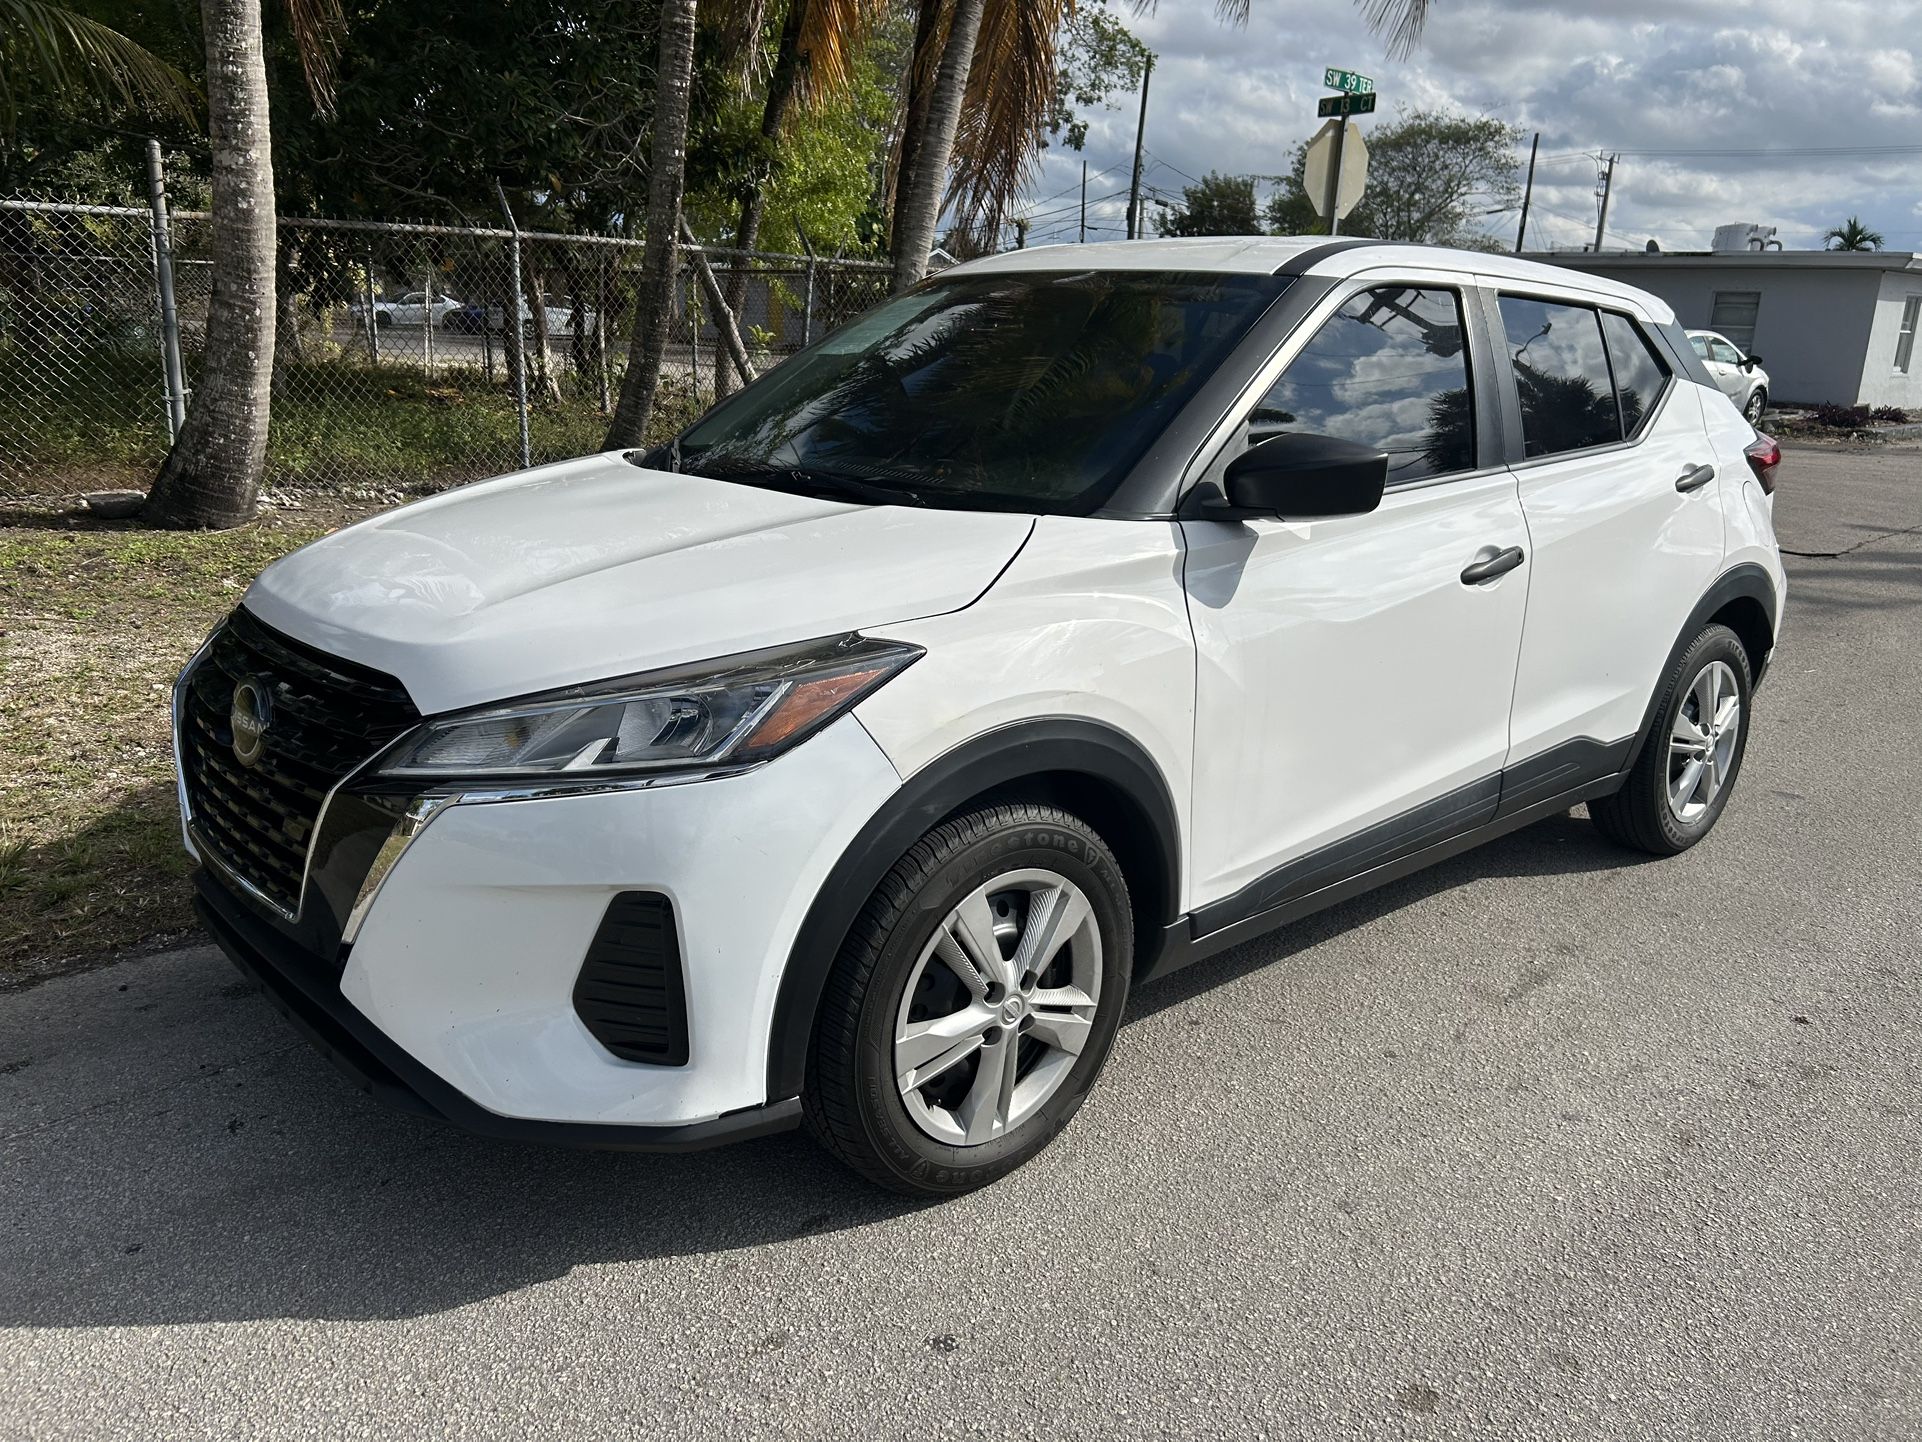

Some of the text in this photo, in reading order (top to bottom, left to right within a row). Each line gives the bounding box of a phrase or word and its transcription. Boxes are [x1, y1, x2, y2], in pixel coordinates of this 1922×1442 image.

[1326, 70, 1372, 93] SW 39 TER
[1320, 96, 1373, 115] SW 13 CT
